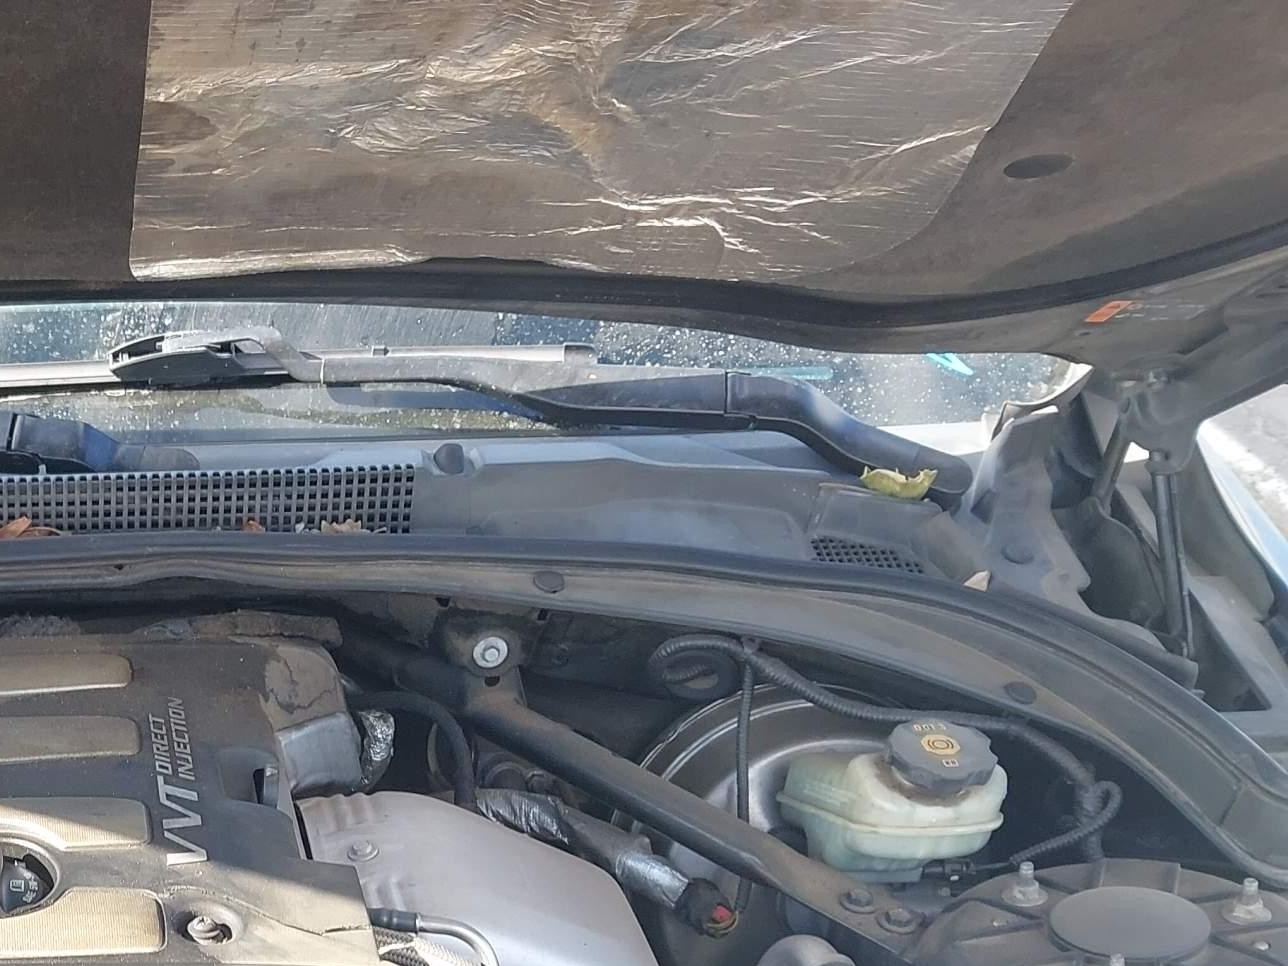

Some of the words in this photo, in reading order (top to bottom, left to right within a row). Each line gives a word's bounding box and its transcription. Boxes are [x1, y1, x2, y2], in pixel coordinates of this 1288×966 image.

[149, 714, 172, 775] DIRECT
[168, 698, 194, 780] INJECTION
[157, 775, 207, 866] VVT
